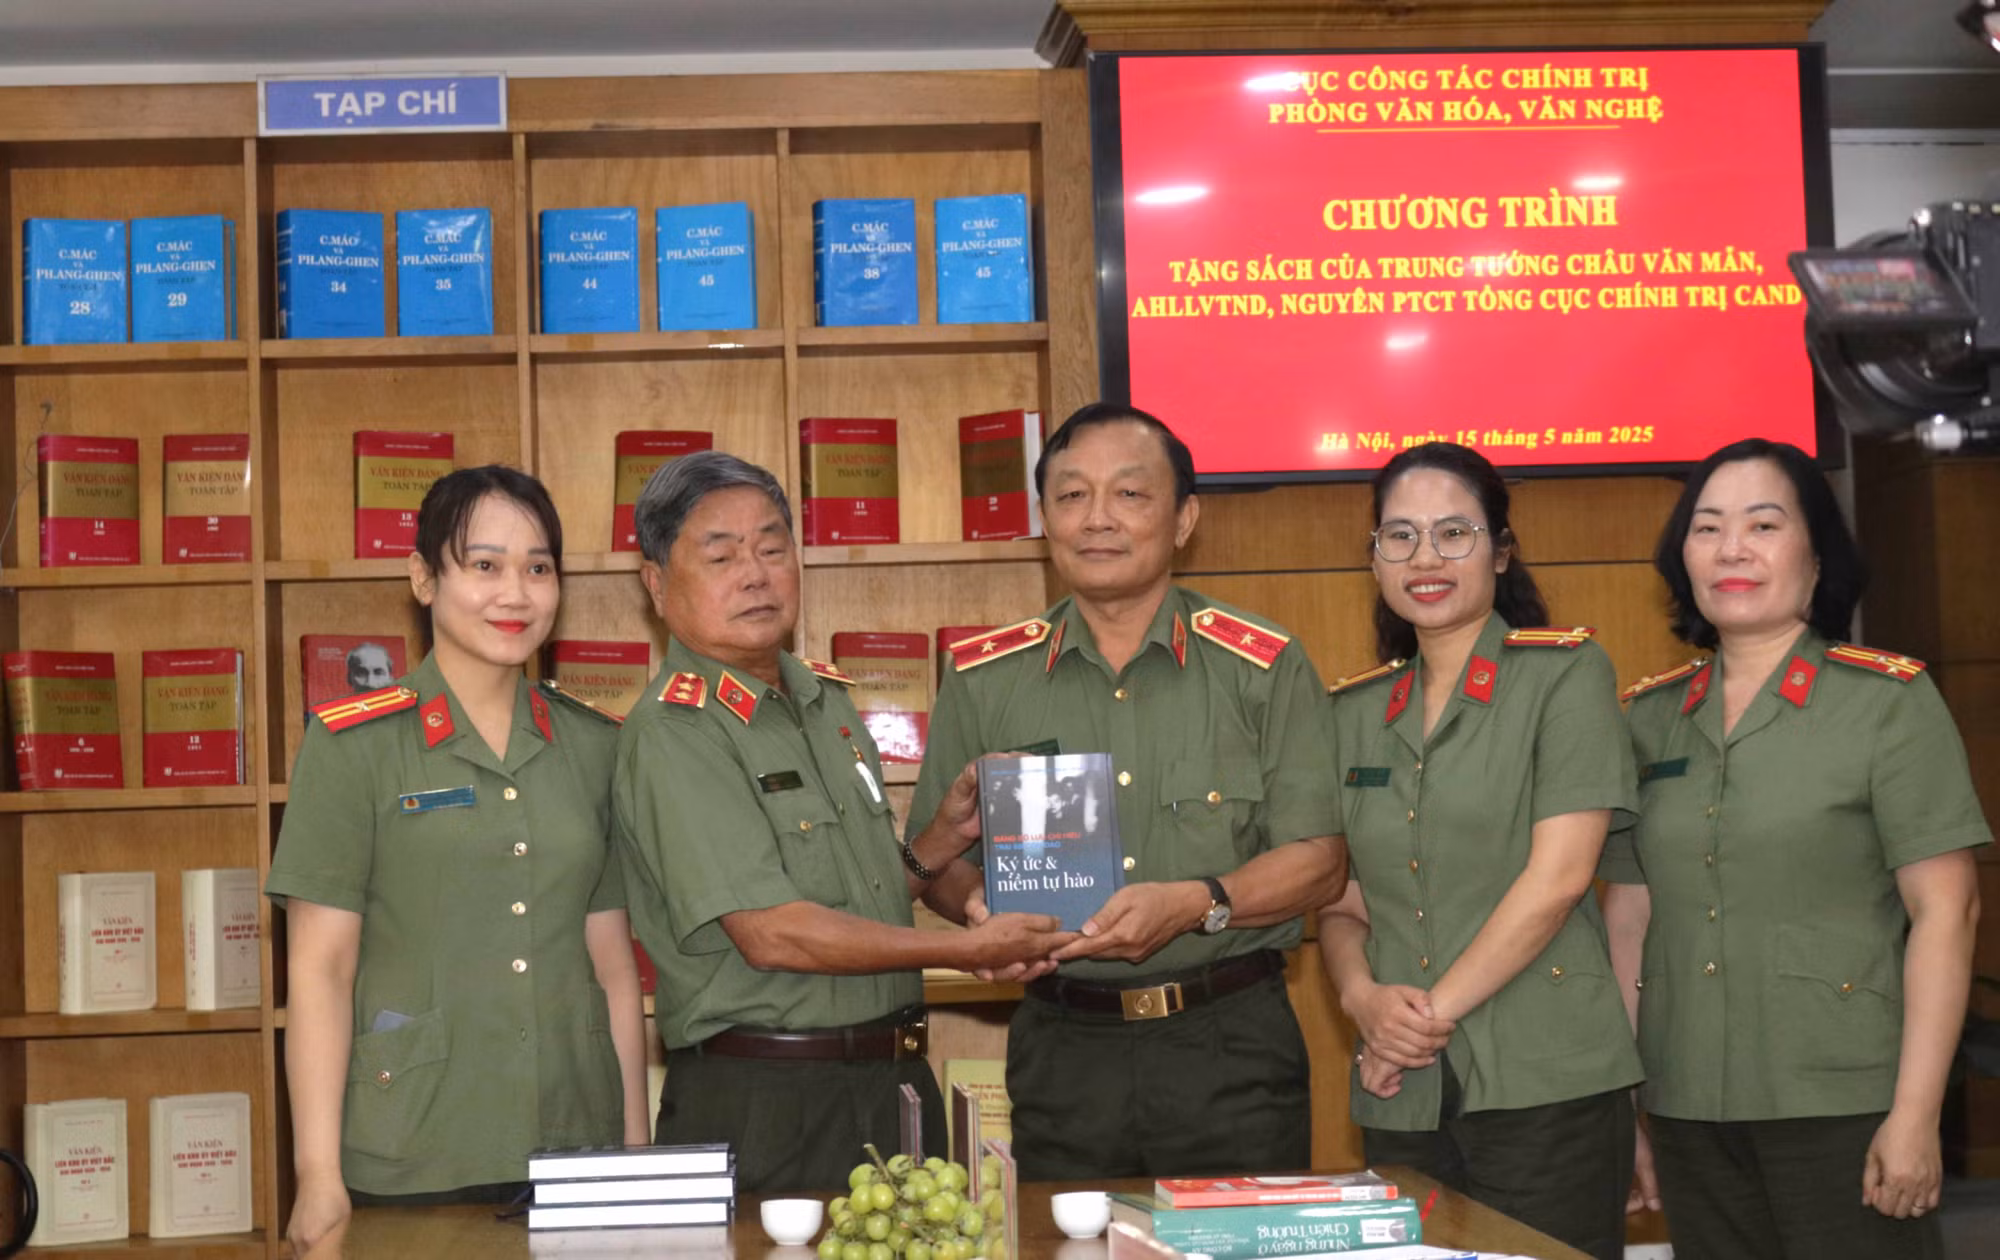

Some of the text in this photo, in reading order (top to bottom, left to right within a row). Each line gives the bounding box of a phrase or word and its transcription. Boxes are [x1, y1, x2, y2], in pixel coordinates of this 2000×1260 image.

[1348, 65, 1428, 91] CÔNG
[1436, 64, 1493, 90] TÁC
[1501, 64, 1592, 89] CHÍNH
[1600, 67, 1649, 91] TRỊ
[314, 83, 458, 124] TẠP CHÍ
[1268, 95, 1664, 123] PHÒNG VĂN HÓA, VĂN NGHỆ
[1322, 187, 1618, 230] CHƯƠNG TRÌNH
[1168, 258, 1239, 287] TẶNG
[1246, 254, 1313, 281] SÁCH
[1320, 253, 1372, 280] CỦA
[1378, 256, 1464, 279] TRUNG
[1470, 250, 1559, 278] TƯỚNG
[1566, 248, 1635, 275] CHÂU
[1642, 248, 1692, 273] VĂN
[70, 301, 90, 315] 28
[167, 293, 187, 307] 29
[1131, 294, 1274, 318] AHLLVTND,
[1280, 286, 1384, 315] NGUYÊN
[1392, 290, 1456, 313] PTCT
[1540, 288, 1590, 315] CỤC
[1598, 281, 1678, 308] CHÍNH
[1684, 286, 1727, 312] TRỊ
[1734, 284, 1802, 306] CAND
[1321, 432, 1349, 450] Hà
[1356, 431, 1396, 453] Nội,
[1457, 430, 1477, 447] 15
[1484, 428, 1538, 449] tháng
[1544, 428, 1555, 445] 5
[1562, 427, 1602, 445] năm
[1608, 426, 1654, 444] 2025
[996, 855, 1057, 872] Ký ức &
[997, 872, 1094, 892] niềm tự hào
[1309, 1223, 1349, 1239] Chiến
[1270, 1239, 1303, 1255] ngày
